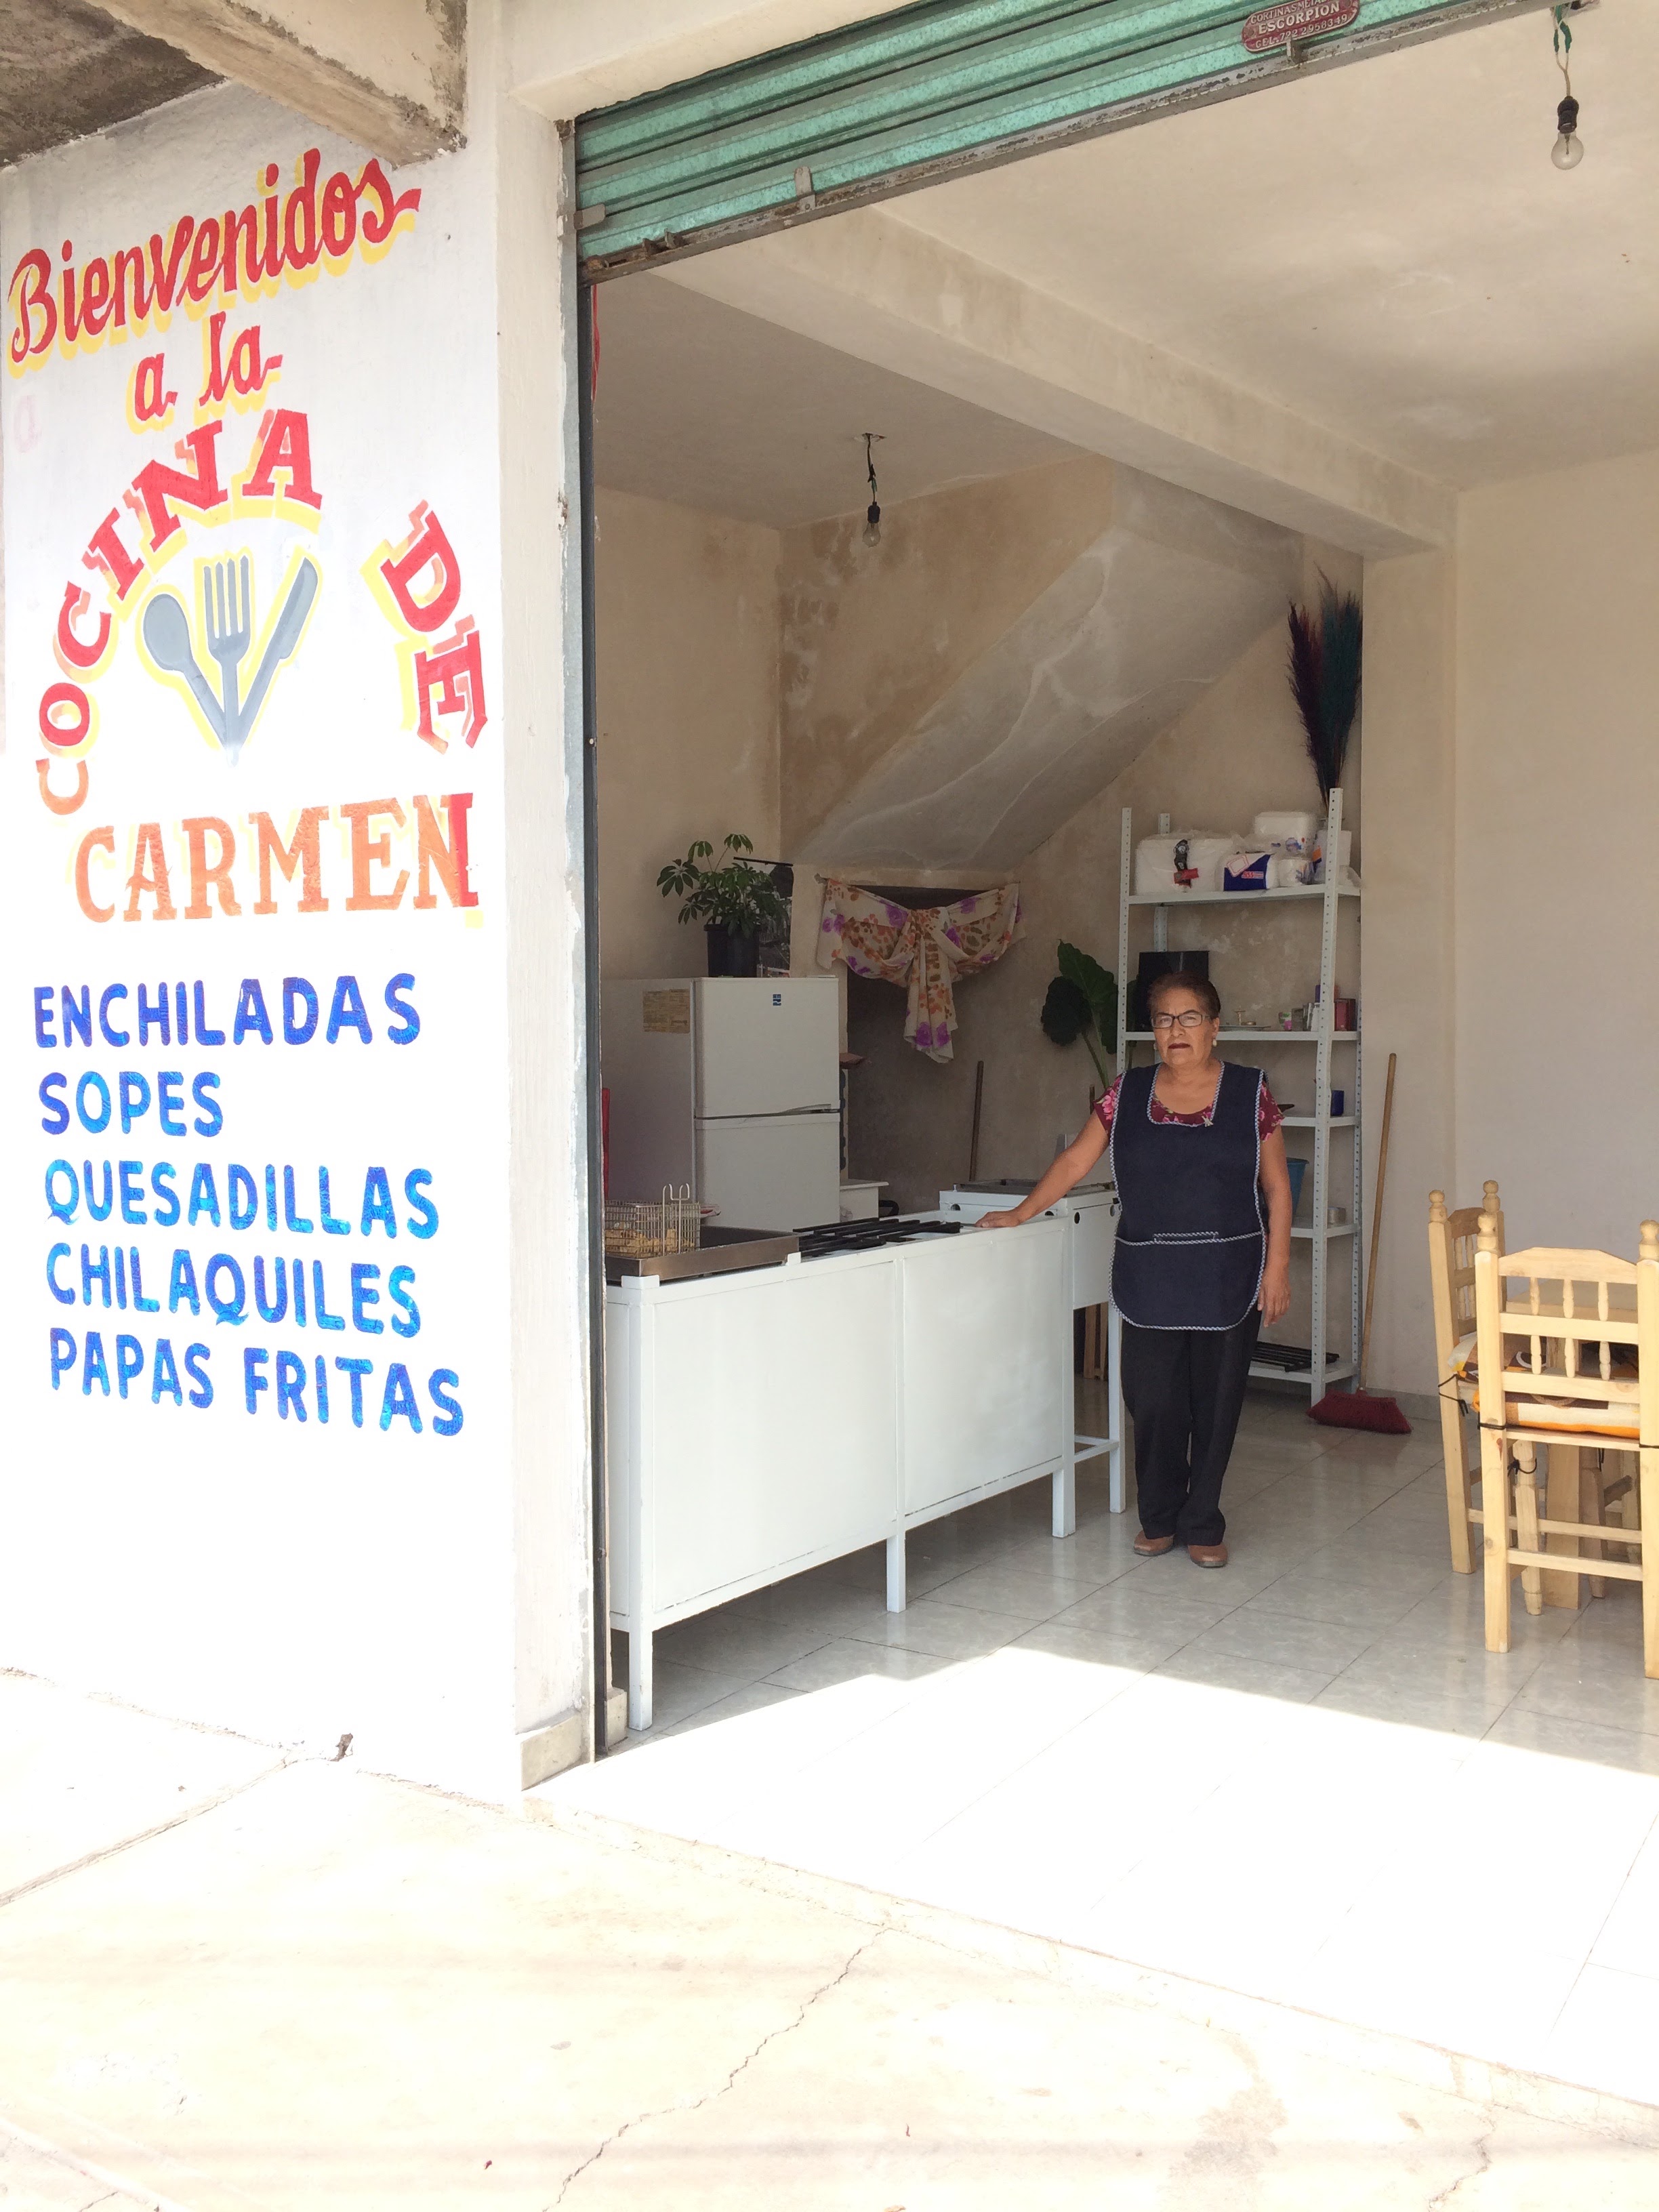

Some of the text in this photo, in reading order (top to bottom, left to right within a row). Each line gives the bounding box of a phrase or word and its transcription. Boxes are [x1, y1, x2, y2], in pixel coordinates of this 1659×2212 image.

[1250, 3, 1297, 24] CORTINAS
[1258, 1, 1340, 34] ESCORPION
[1301, 14, 1347, 35] 2958349
[9, 148, 422, 363] Bienvenidos
[134, 310, 283, 422] a la
[36, 409, 488, 815] COCINA DE
[75, 792, 479, 923] CARMEN
[34, 972, 421, 1048] ENCHILADAS
[39, 1071, 223, 1137] SOPES
[45, 1159, 439, 1240] QUESADILLAS
[46, 1243, 422, 1338] CHILAQUILES
[50, 1328, 464, 1437] PAPAS FRITAS
